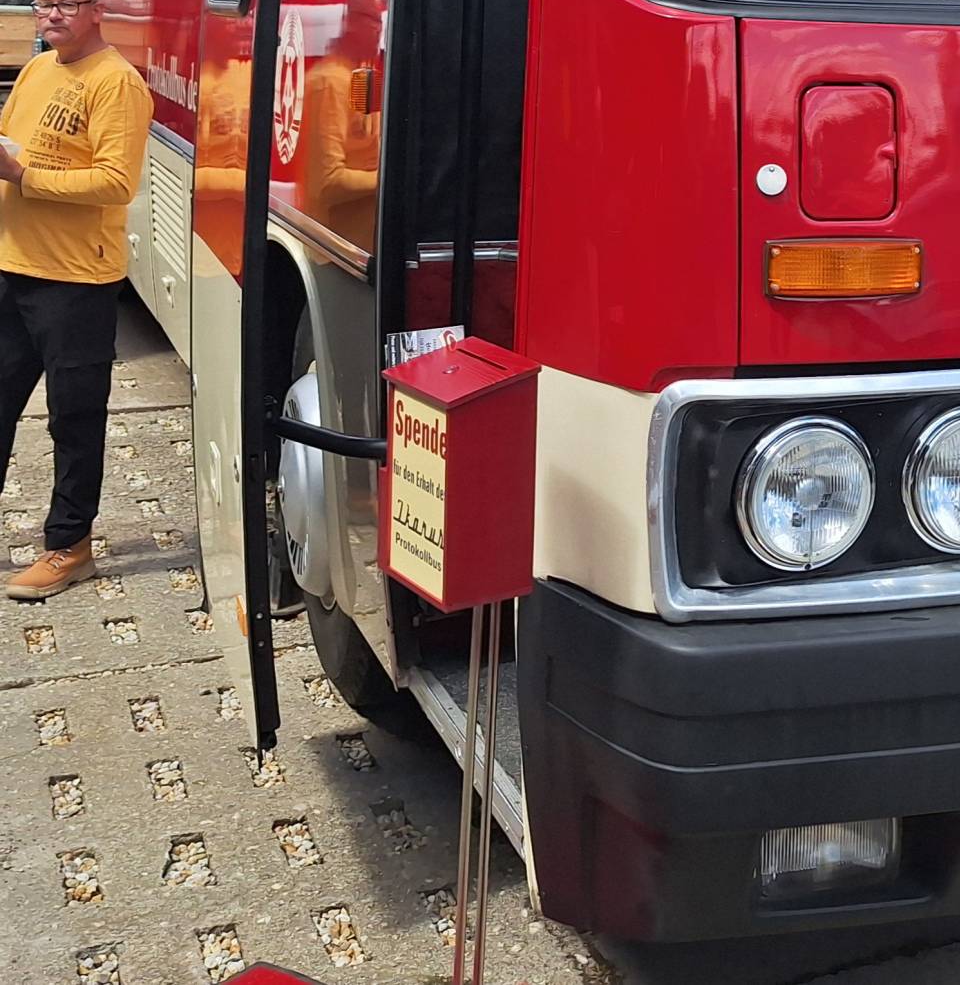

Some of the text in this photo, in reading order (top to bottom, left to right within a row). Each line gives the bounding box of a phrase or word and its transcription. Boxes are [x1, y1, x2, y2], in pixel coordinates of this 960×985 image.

[38, 102, 80, 136] 1969
[395, 399, 447, 460] Spende
[393, 459, 402, 477] für
[403, 464, 415, 485] den
[416, 471, 435, 497] Erhalt
[396, 532, 442, 572] Protokollbus
